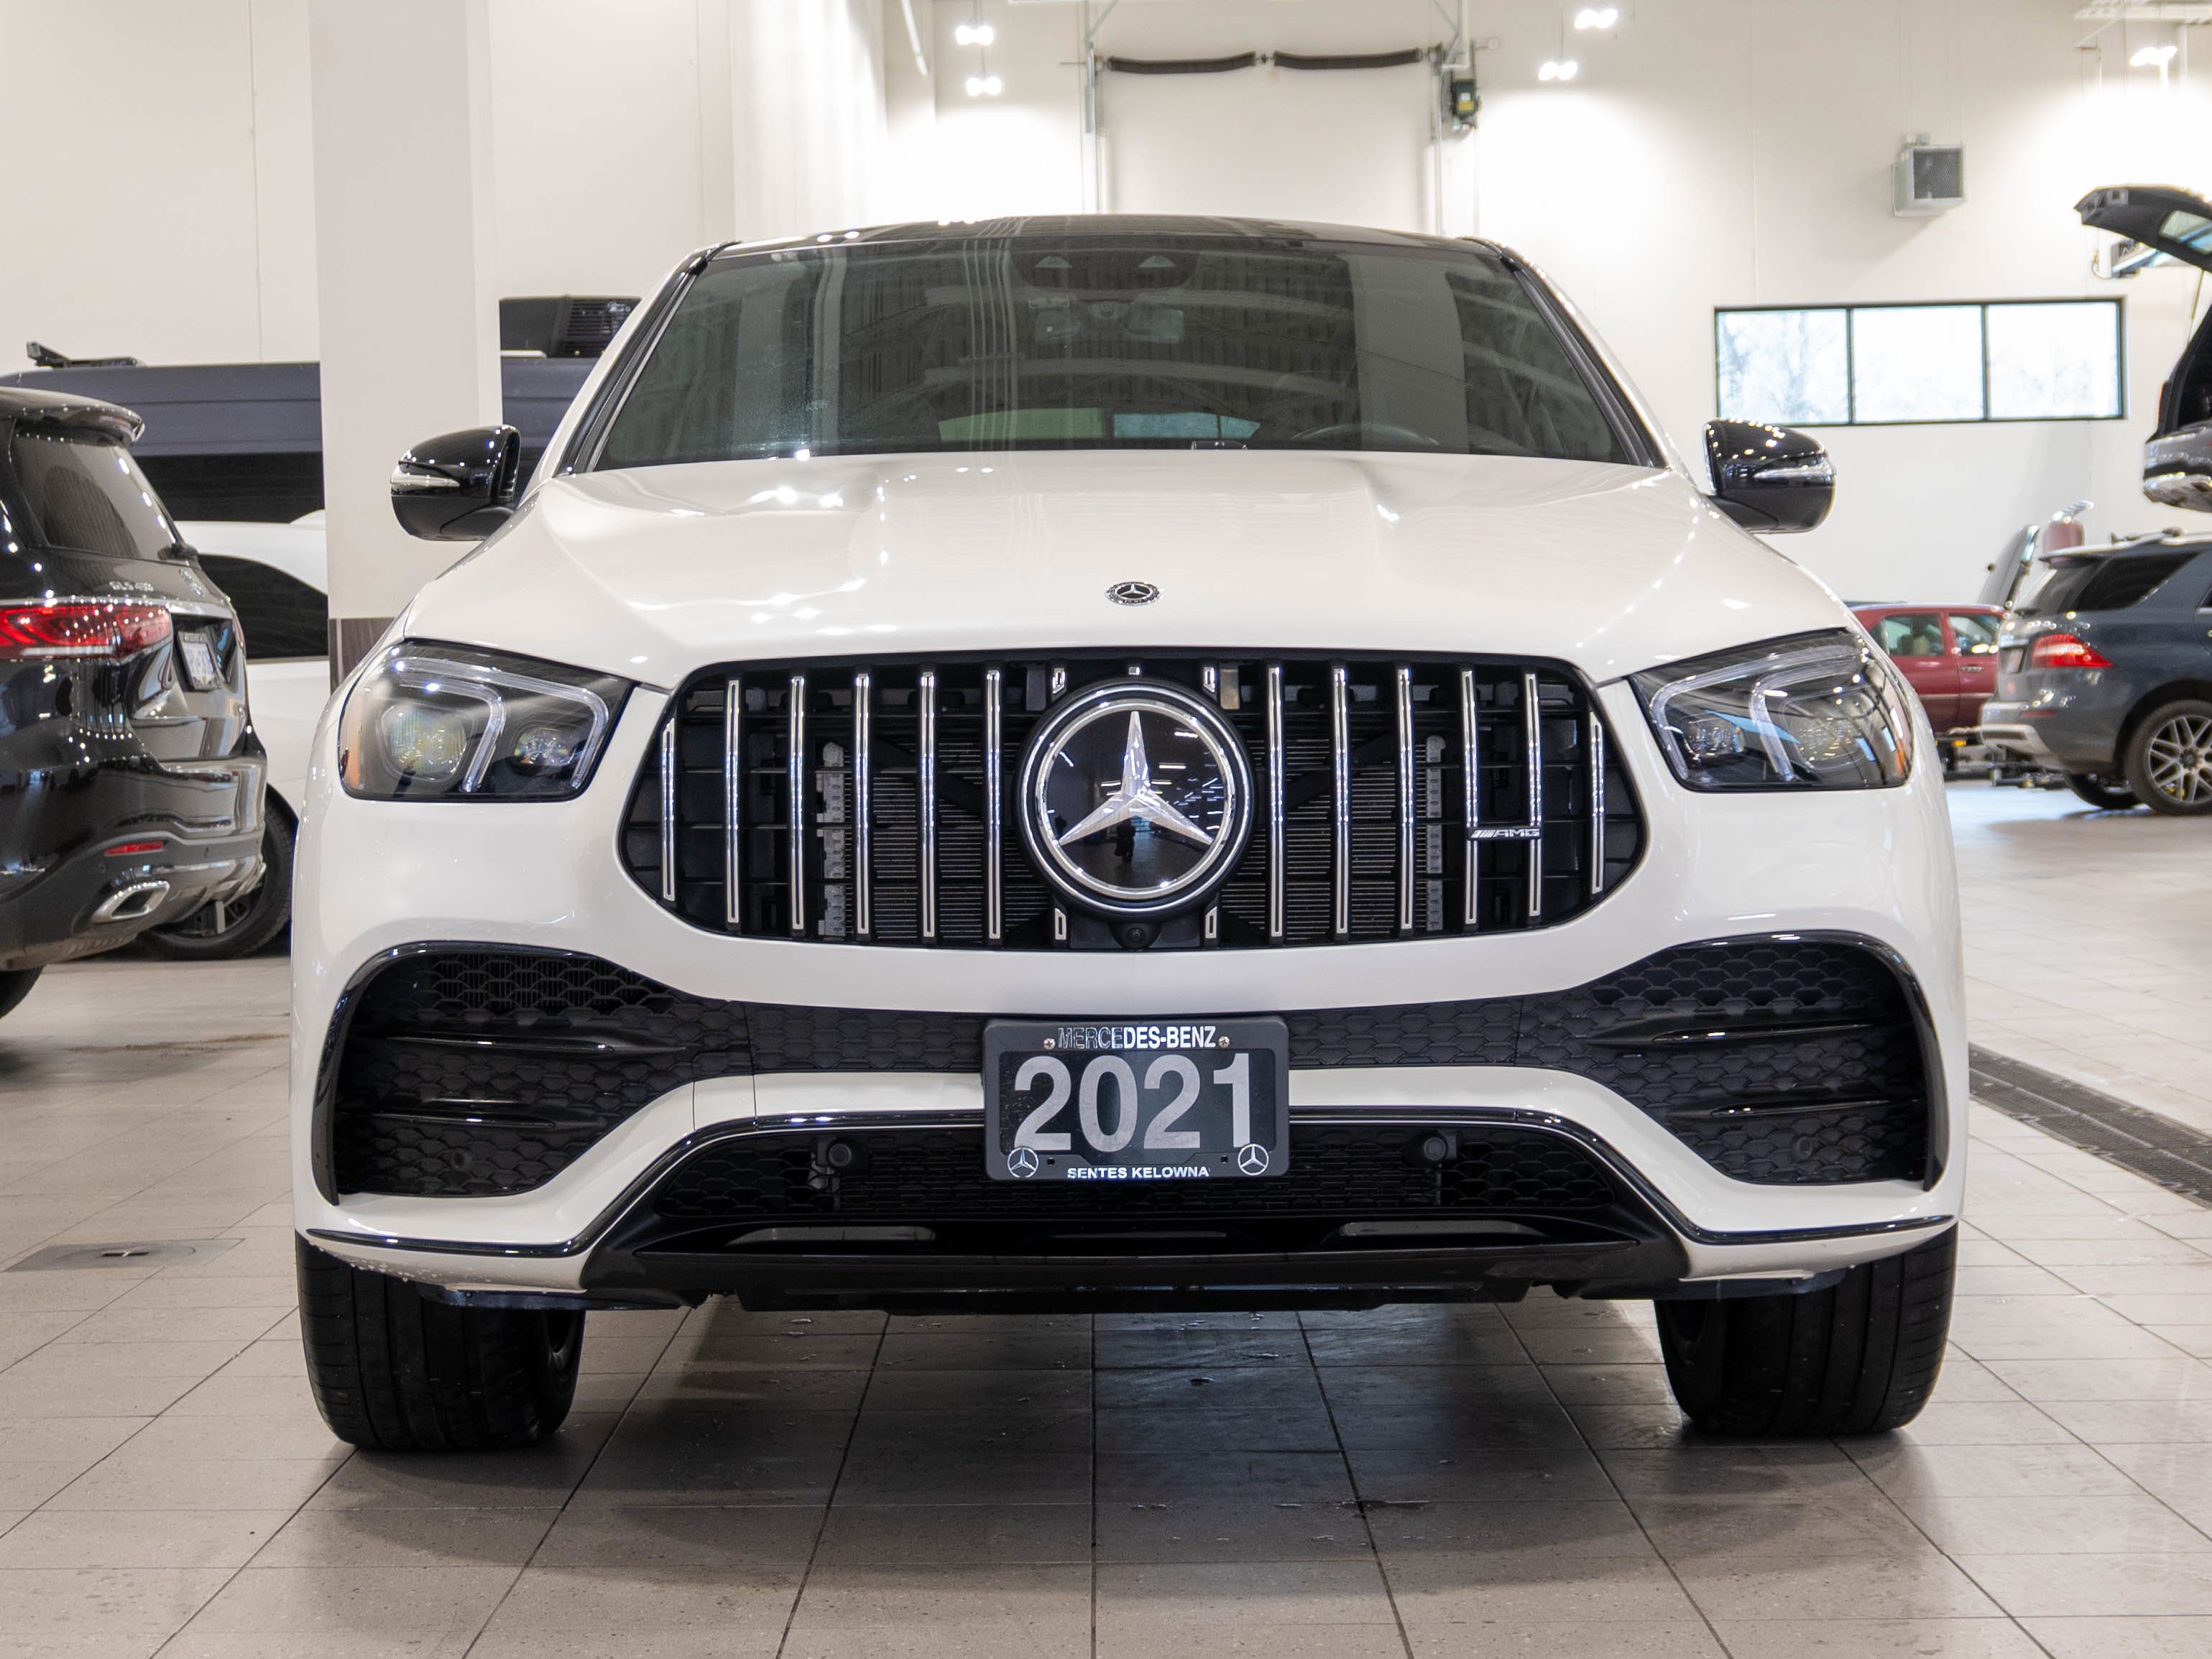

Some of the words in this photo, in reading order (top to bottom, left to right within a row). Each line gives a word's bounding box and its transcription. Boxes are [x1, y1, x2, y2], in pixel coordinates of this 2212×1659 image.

[1058, 1025, 1217, 1049] MERCEDES-BENZ
[1014, 1053, 1250, 1152] 2021
[1067, 1167, 1128, 1179] SENTES
[1131, 1166, 1210, 1178] KELOWNA
